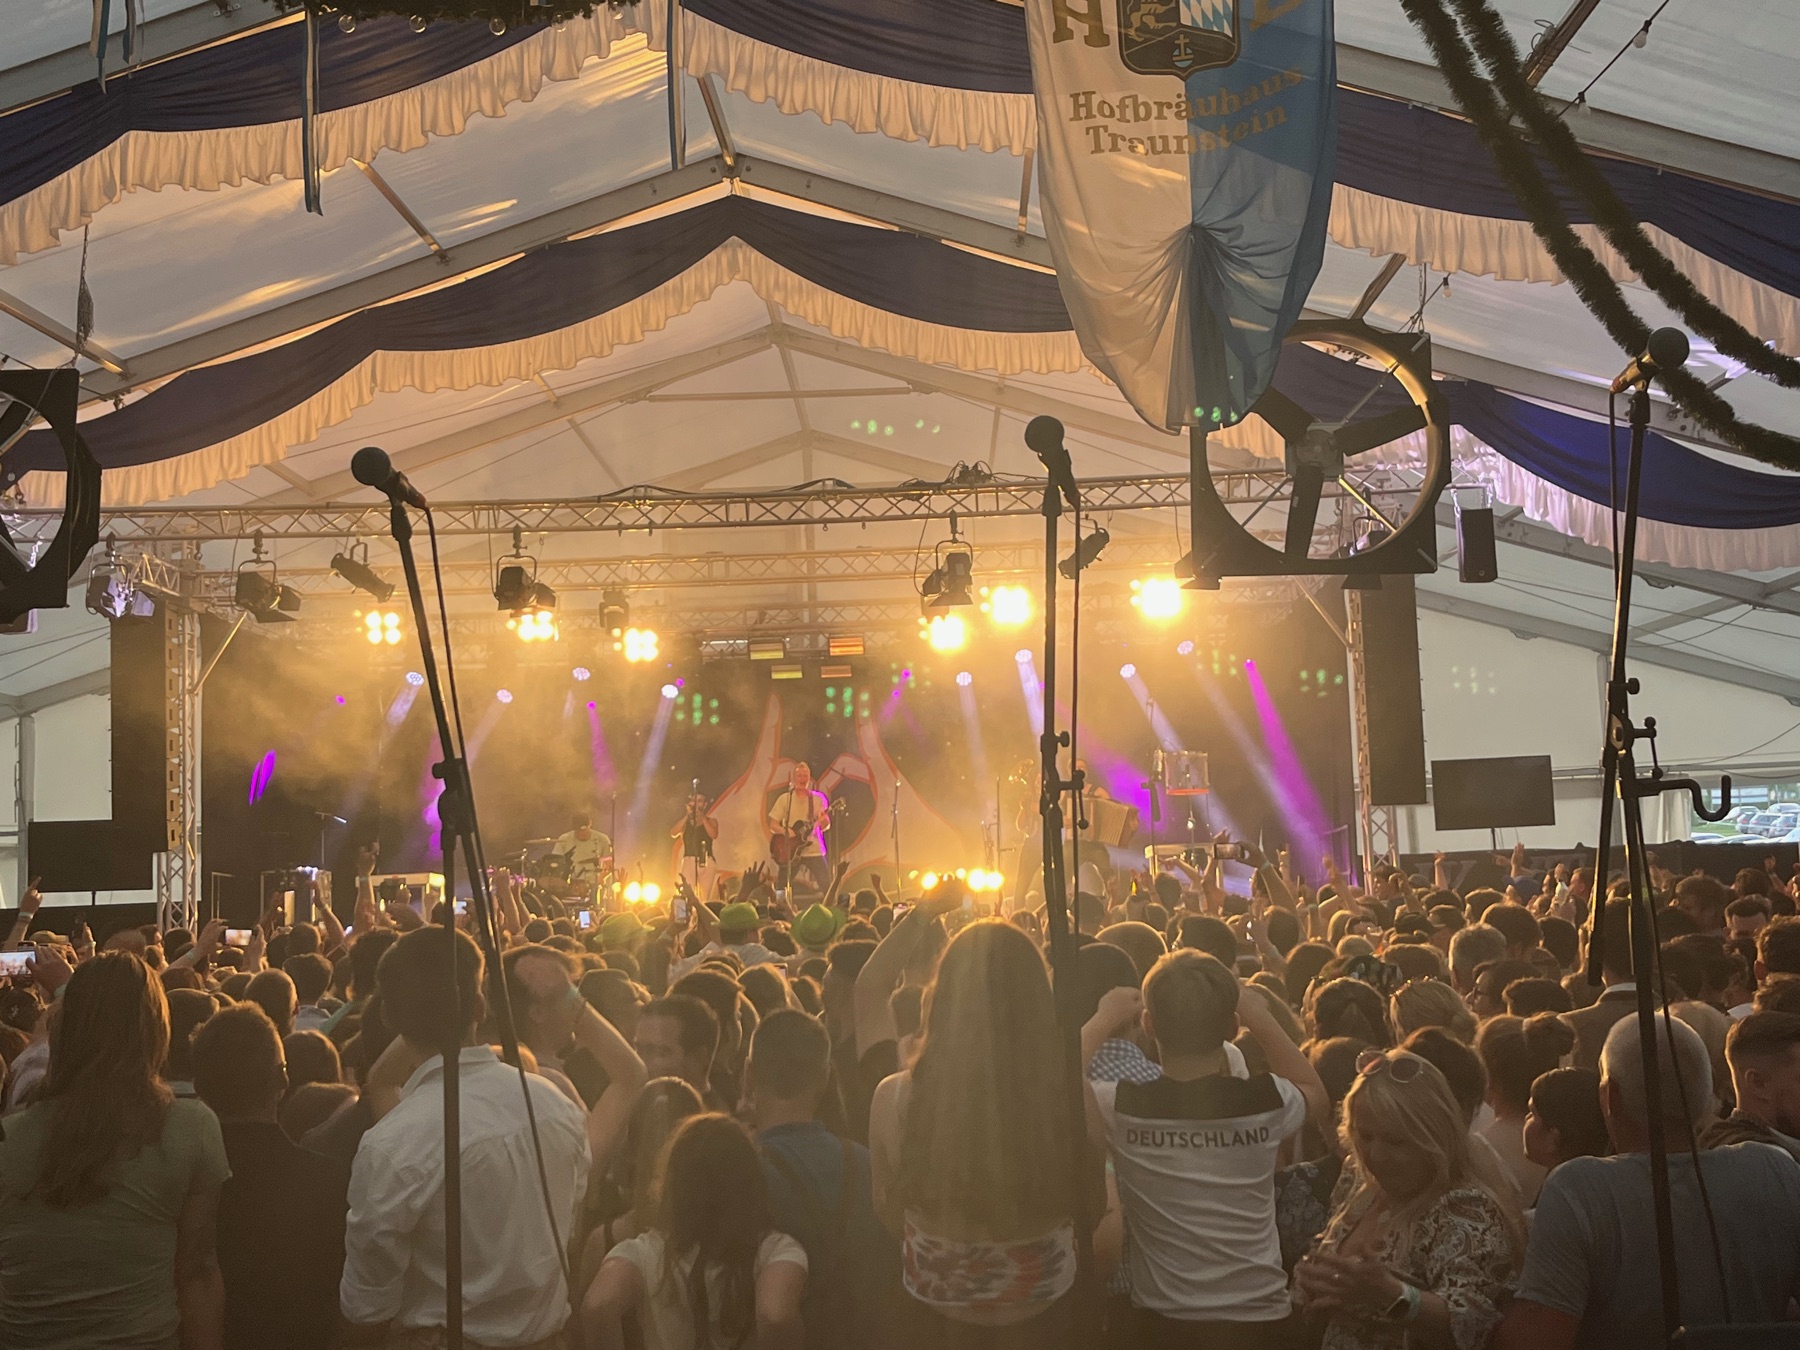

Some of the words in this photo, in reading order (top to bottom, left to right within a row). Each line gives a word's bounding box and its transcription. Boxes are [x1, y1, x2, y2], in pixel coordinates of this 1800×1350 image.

[1068, 66, 1303, 123] Hofbräuhaus
[1085, 104, 1288, 156] Traunstein
[1126, 1126, 1270, 1149] DEUTSCHLAND
